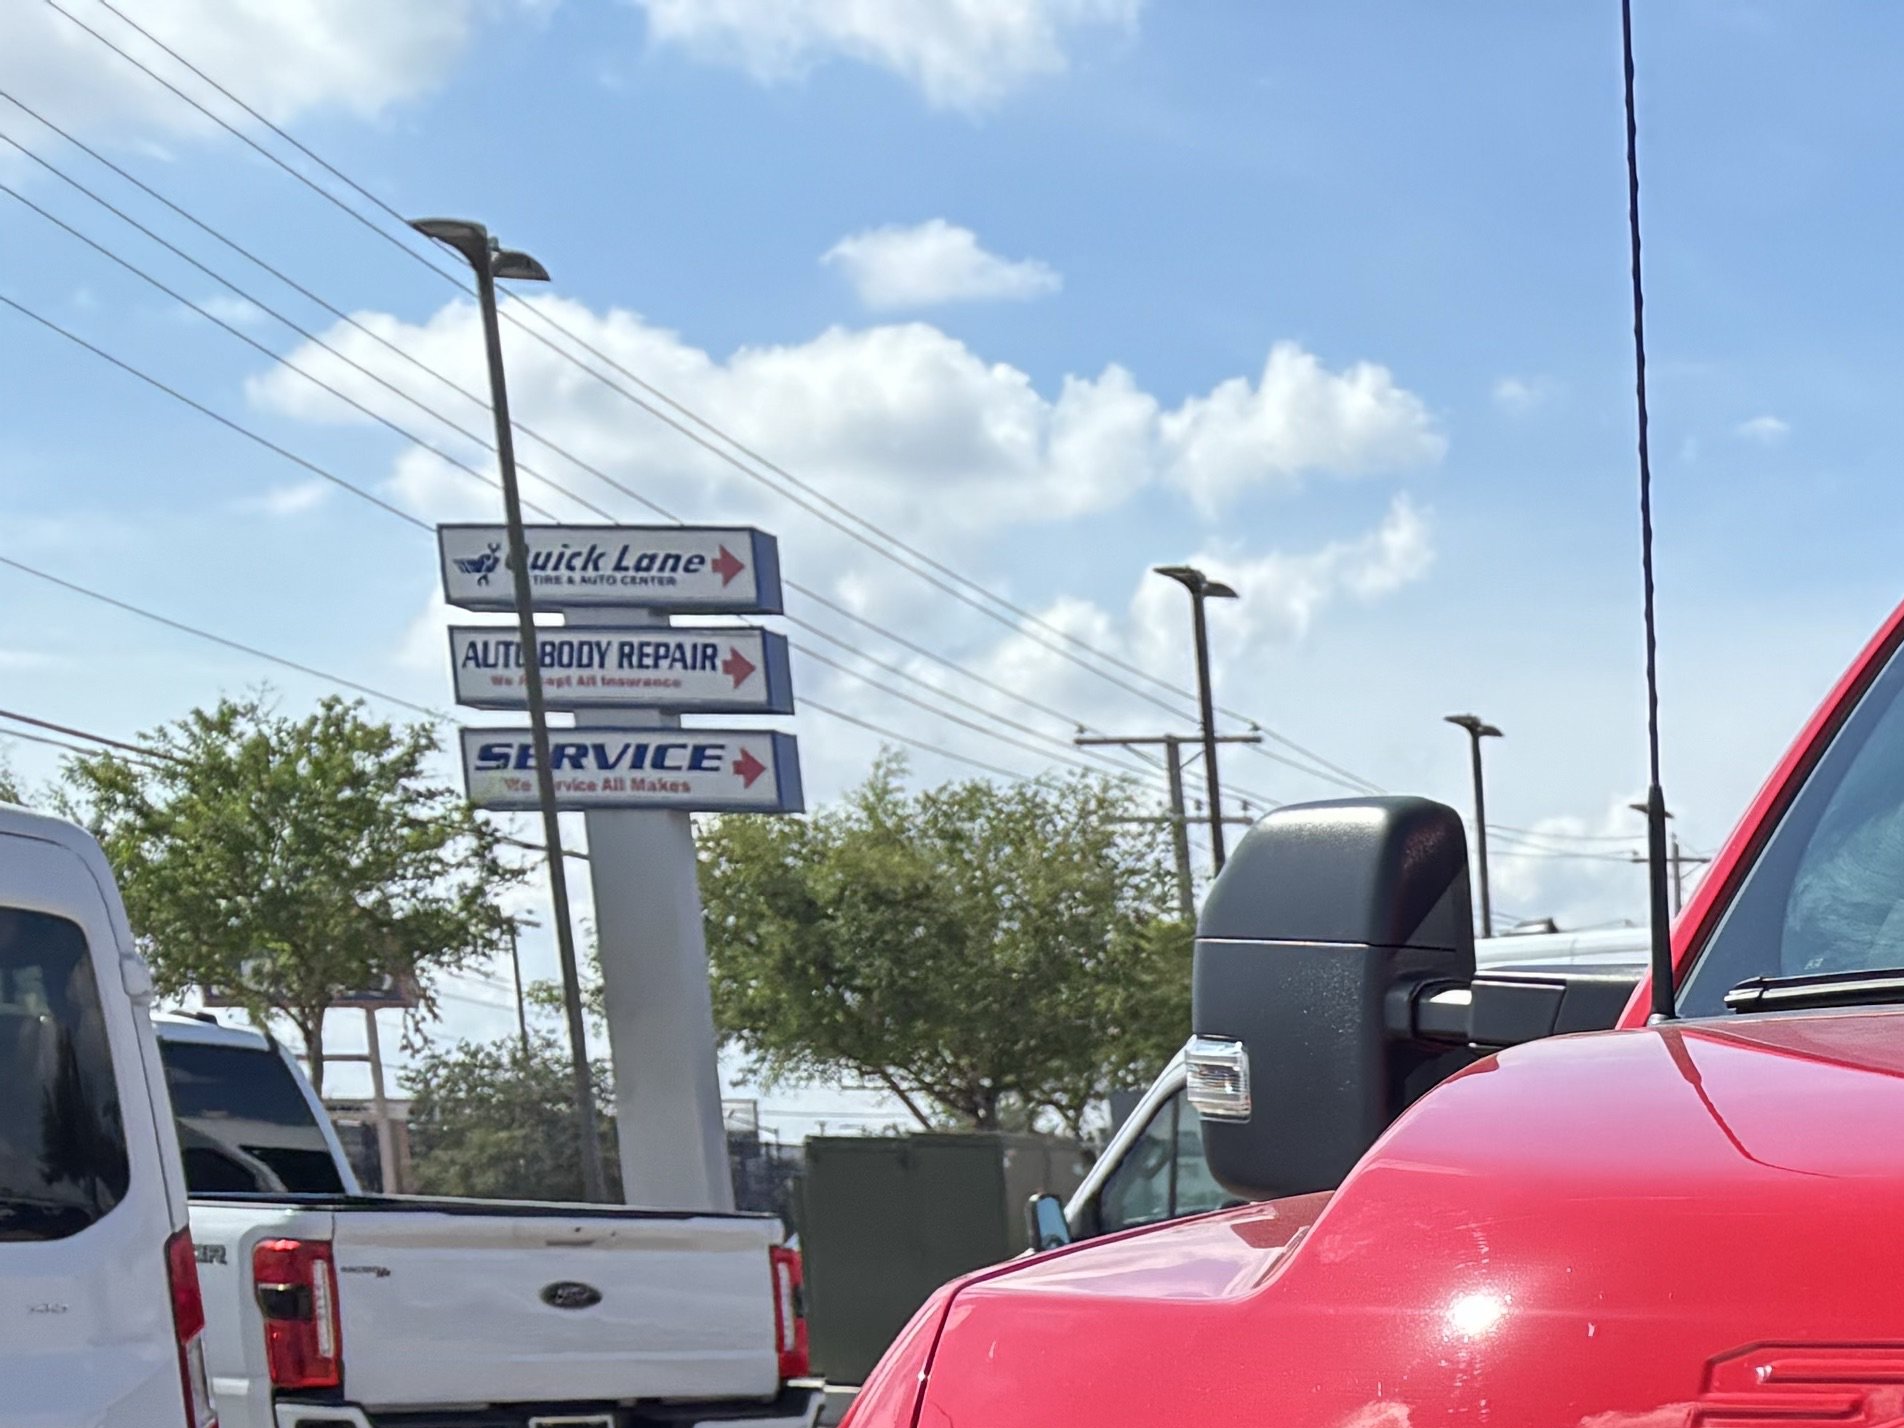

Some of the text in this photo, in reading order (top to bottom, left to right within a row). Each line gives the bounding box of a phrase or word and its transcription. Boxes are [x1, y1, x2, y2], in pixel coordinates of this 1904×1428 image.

[612, 544, 706, 574] Lane
[533, 575, 562, 585] TIRE
[580, 575, 617, 586] AUTO
[621, 575, 677, 586] CENTER
[539, 641, 611, 669] BODY
[618, 641, 718, 671] REPAIR
[601, 677, 682, 688] Insurance
[474, 743, 726, 771] SERVICE
[602, 778, 625, 792] All
[631, 779, 692, 793] Makes
